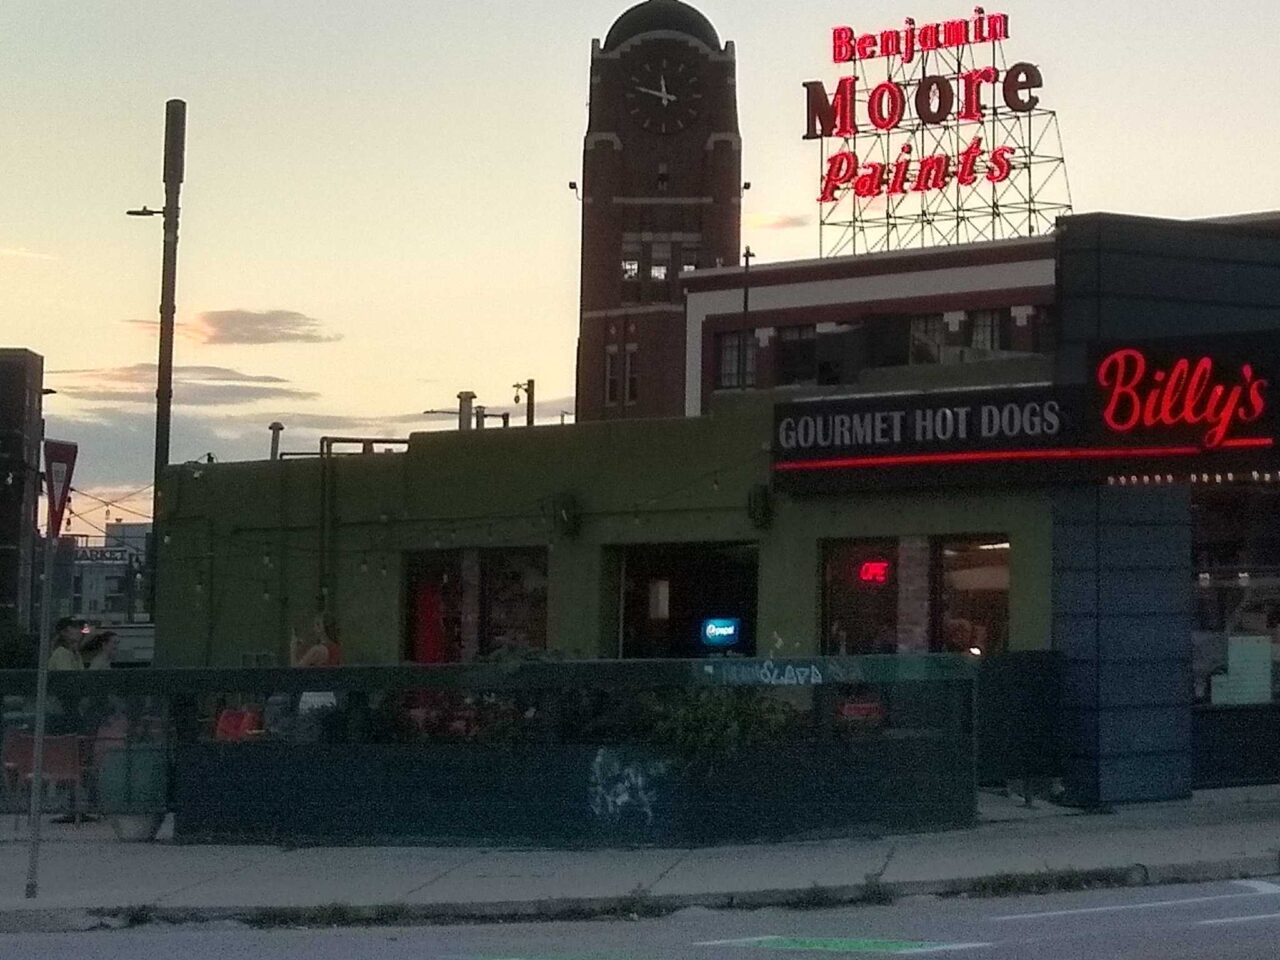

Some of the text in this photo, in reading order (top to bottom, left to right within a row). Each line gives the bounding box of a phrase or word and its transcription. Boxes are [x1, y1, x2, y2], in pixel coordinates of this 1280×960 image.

[832, 6, 1010, 64] Benjamin
[802, 62, 1044, 140] Moore
[817, 136, 1016, 202] Paints
[779, 400, 1060, 449] GOURMET HOT DOGS
[1099, 348, 1268, 446] Billy's
